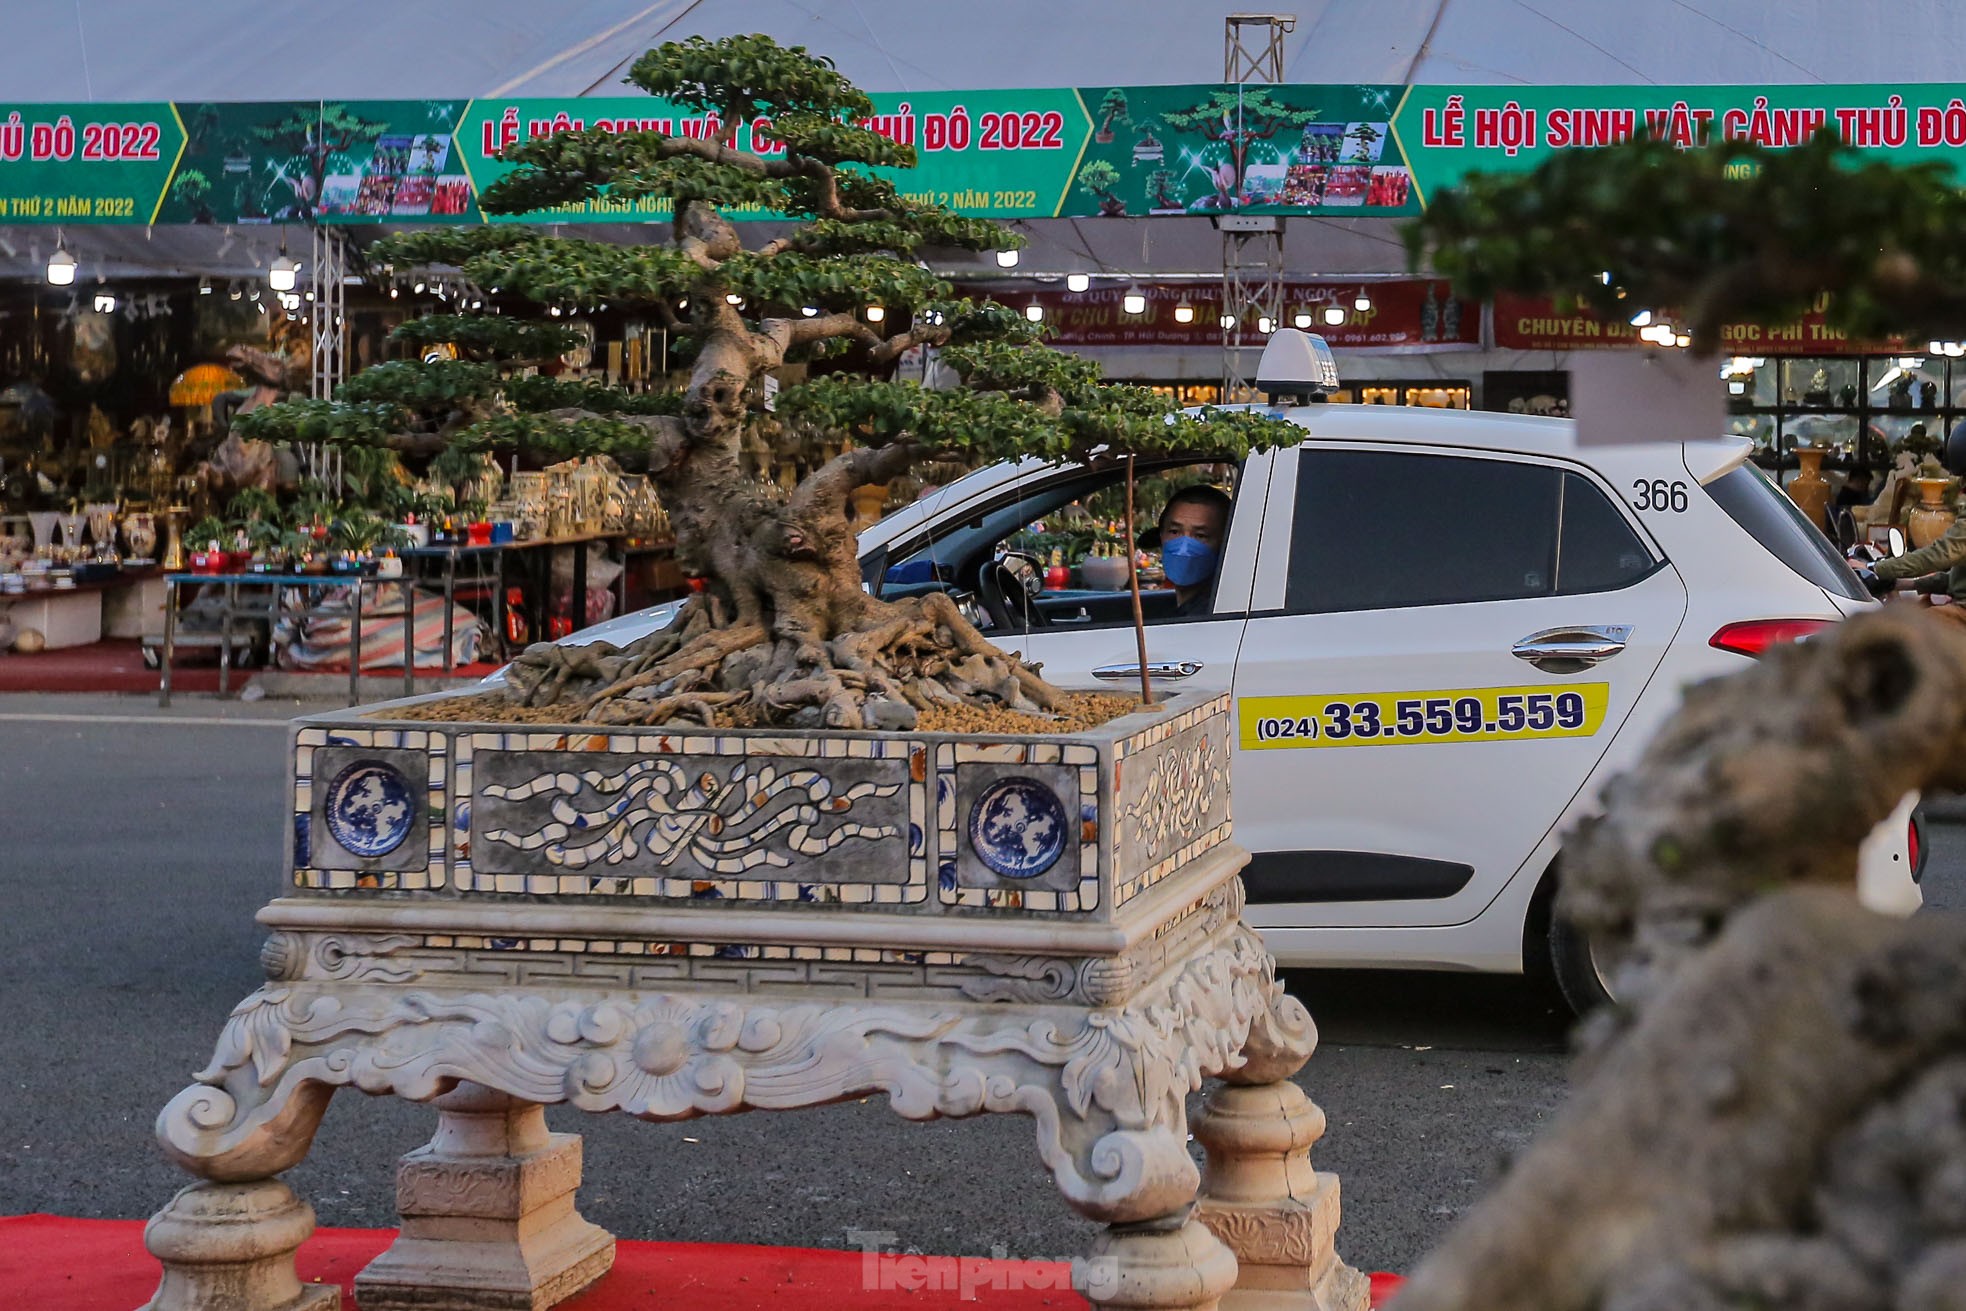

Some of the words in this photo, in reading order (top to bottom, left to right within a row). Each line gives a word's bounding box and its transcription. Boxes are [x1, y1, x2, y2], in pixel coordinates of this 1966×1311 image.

[30, 115, 75, 161] ĐÔ
[82, 122, 160, 161] 2022
[482, 107, 520, 157] LỄ
[923, 104, 971, 151] ĐÔ
[978, 110, 1063, 150] 2022
[1423, 95, 1464, 148] LỄ
[1475, 101, 1537, 157] HỘI
[1546, 109, 1635, 148] SINH
[1835, 94, 1907, 149] THỦ
[44, 197, 54, 217] 2
[57, 194, 91, 217] NĂM
[95, 197, 134, 217] 2022
[938, 192, 949, 206] 2
[953, 188, 989, 209] NĂM
[994, 191, 1036, 208] 2022
[1517, 315, 1601, 337] CHUYÊN
[1720, 323, 1761, 342] GỌC
[1633, 478, 1688, 513] 366
[1257, 717, 1319, 740] (024)
[1323, 692, 1584, 740] 33.559.559
